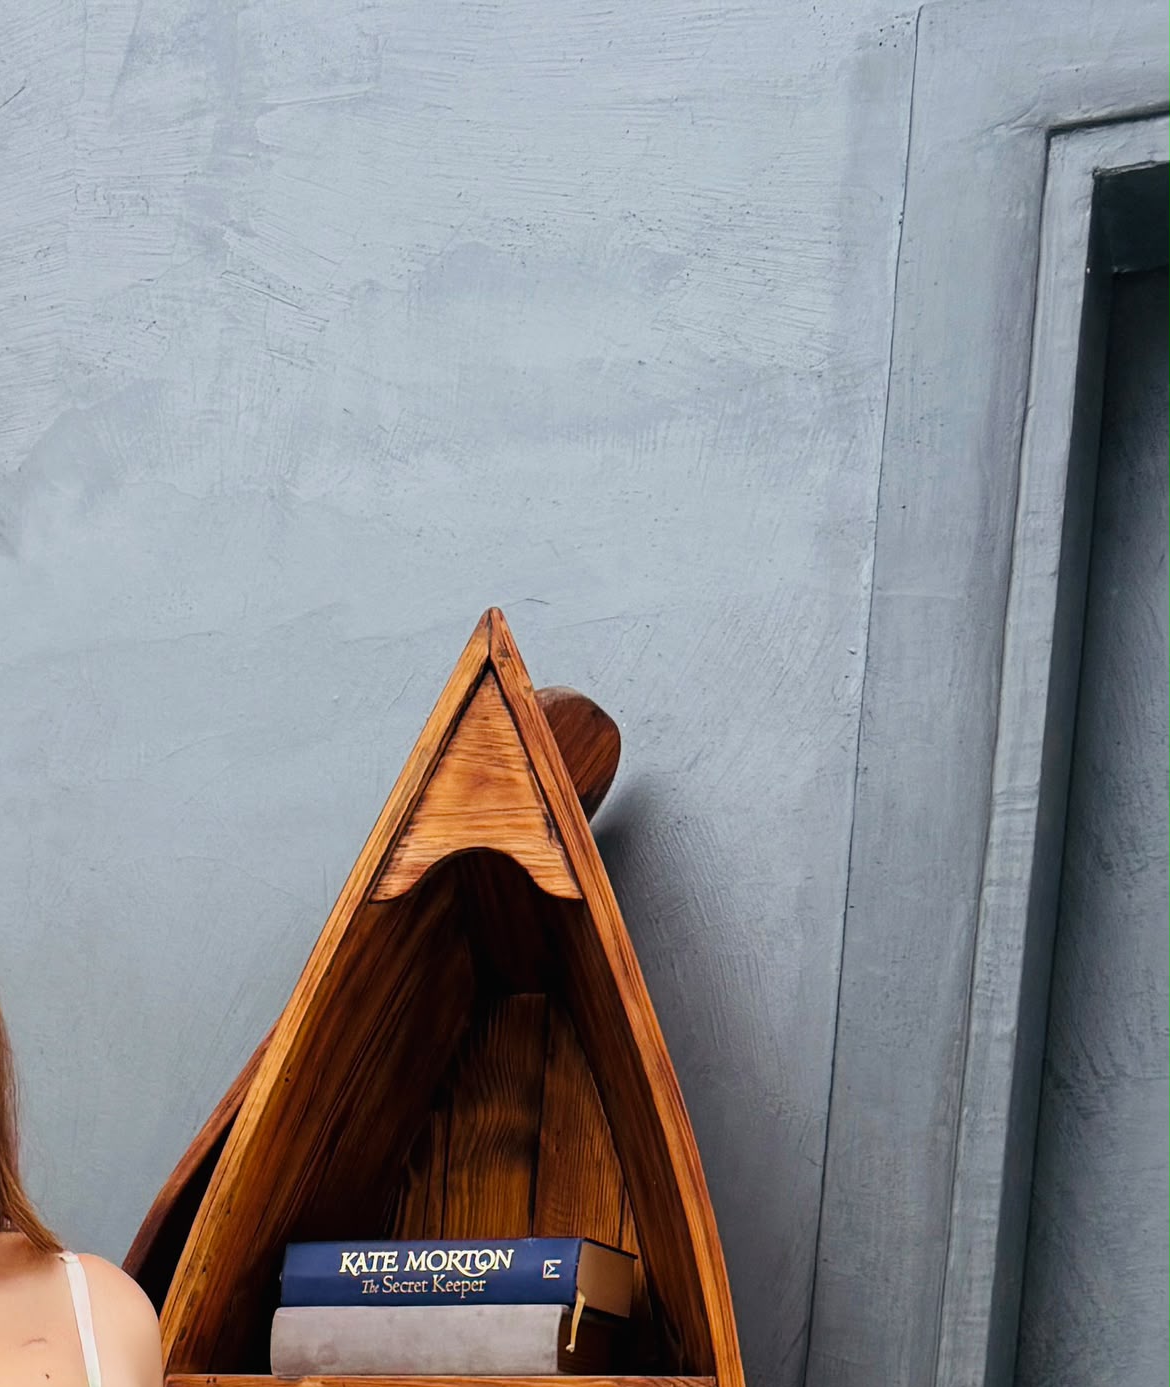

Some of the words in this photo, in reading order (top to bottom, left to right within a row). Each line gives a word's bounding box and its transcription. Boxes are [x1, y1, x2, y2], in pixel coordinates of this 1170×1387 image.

[339, 1251, 398, 1276] KATE
[404, 1249, 514, 1278] MORTON
[362, 1280, 380, 1294] The
[382, 1275, 428, 1294] Secret
[432, 1274, 486, 1299] Keeper
